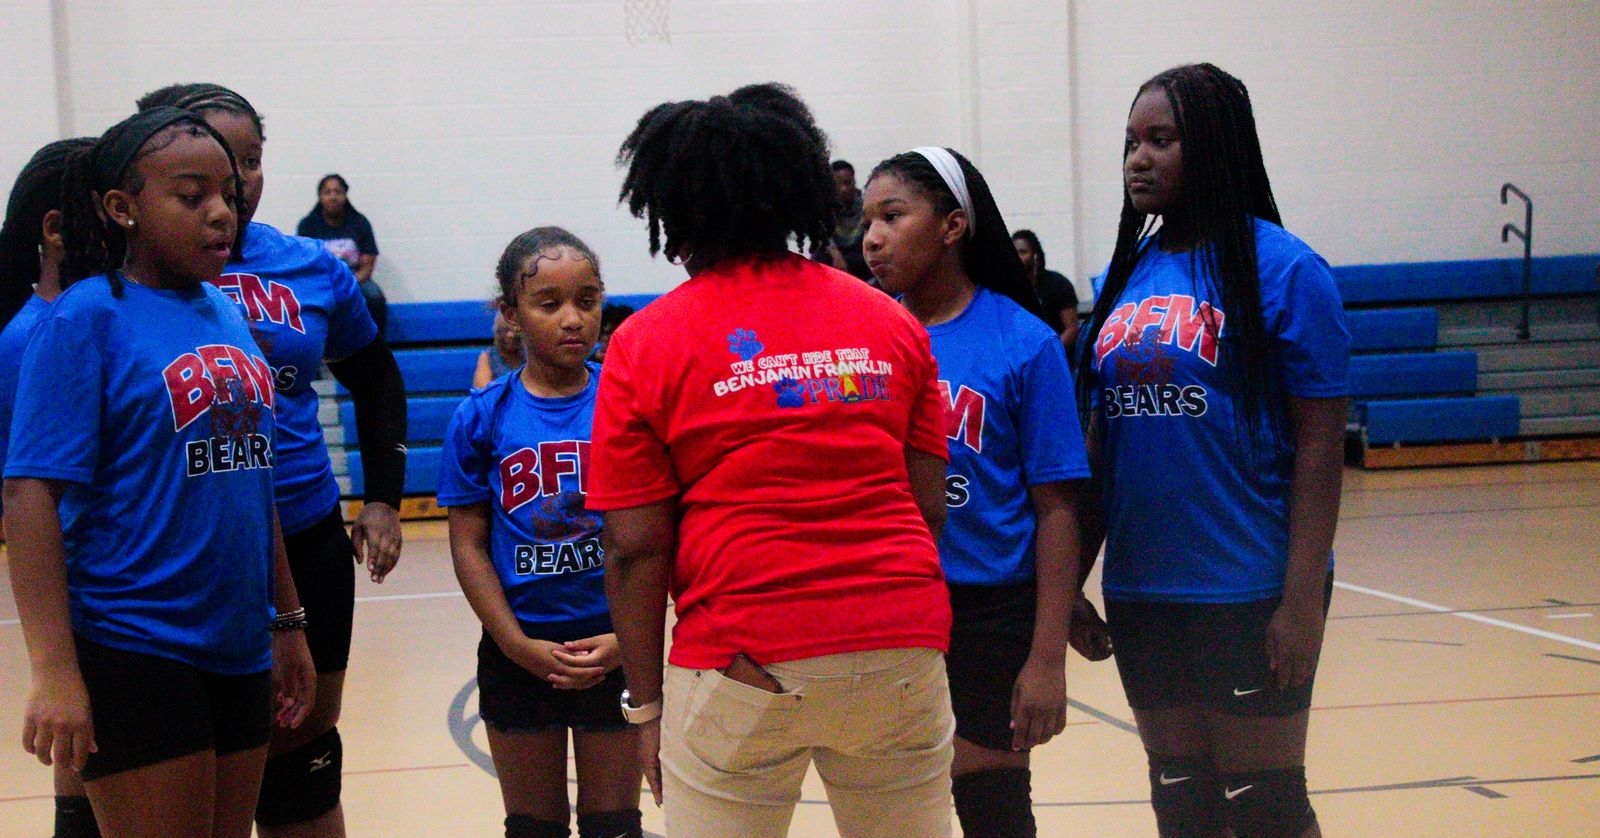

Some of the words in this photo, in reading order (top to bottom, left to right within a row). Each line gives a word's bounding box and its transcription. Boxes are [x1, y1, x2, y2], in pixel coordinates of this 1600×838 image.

[210, 273, 306, 335] FM
[1096, 293, 1226, 373] BFM
[713, 365, 812, 397] BENJAMIN
[813, 359, 893, 379] FRANKLIN
[731, 359, 755, 375] WE
[757, 353, 798, 370] CAN'T
[802, 350, 832, 365] HIDE
[834, 347, 869, 362] THAT
[162, 344, 278, 432] BFM
[804, 374, 891, 404] PRDE
[1104, 384, 1208, 418] BEARS
[500, 440, 592, 514] BF
[515, 537, 605, 576] BEAR
